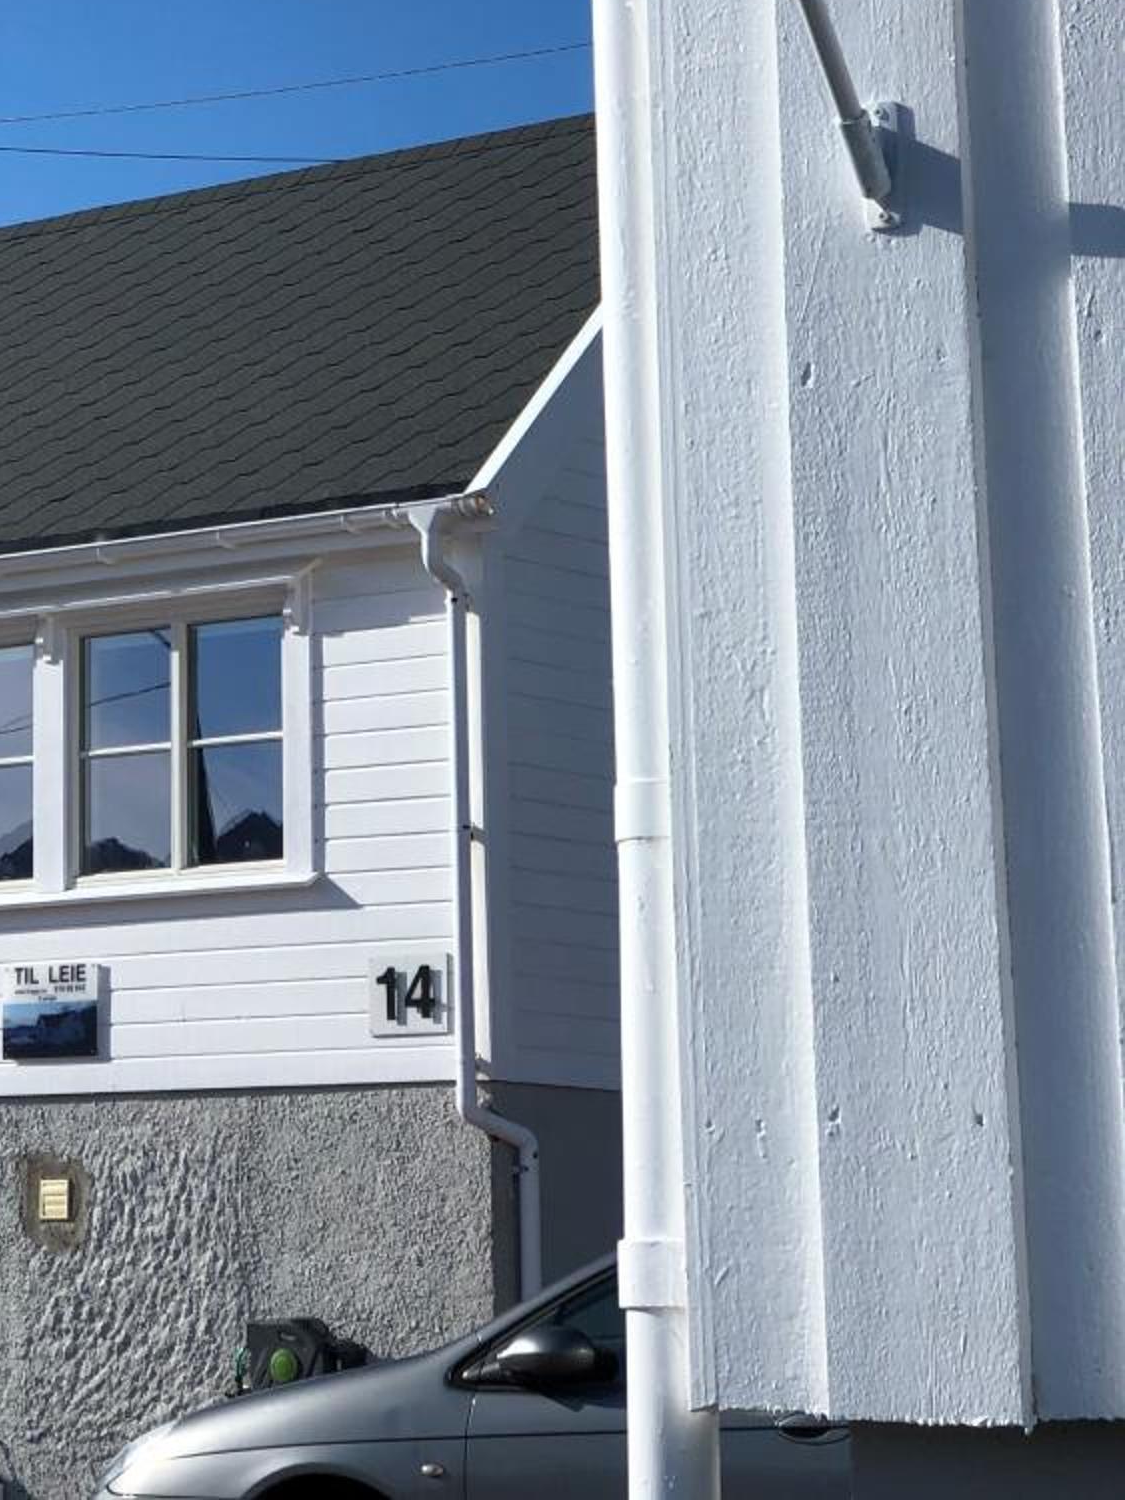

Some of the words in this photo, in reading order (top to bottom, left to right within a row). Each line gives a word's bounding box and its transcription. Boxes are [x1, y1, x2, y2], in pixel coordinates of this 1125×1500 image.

[15, 967, 39, 985] TIL
[48, 963, 86, 983] LEIE
[376, 964, 436, 1021] 14
